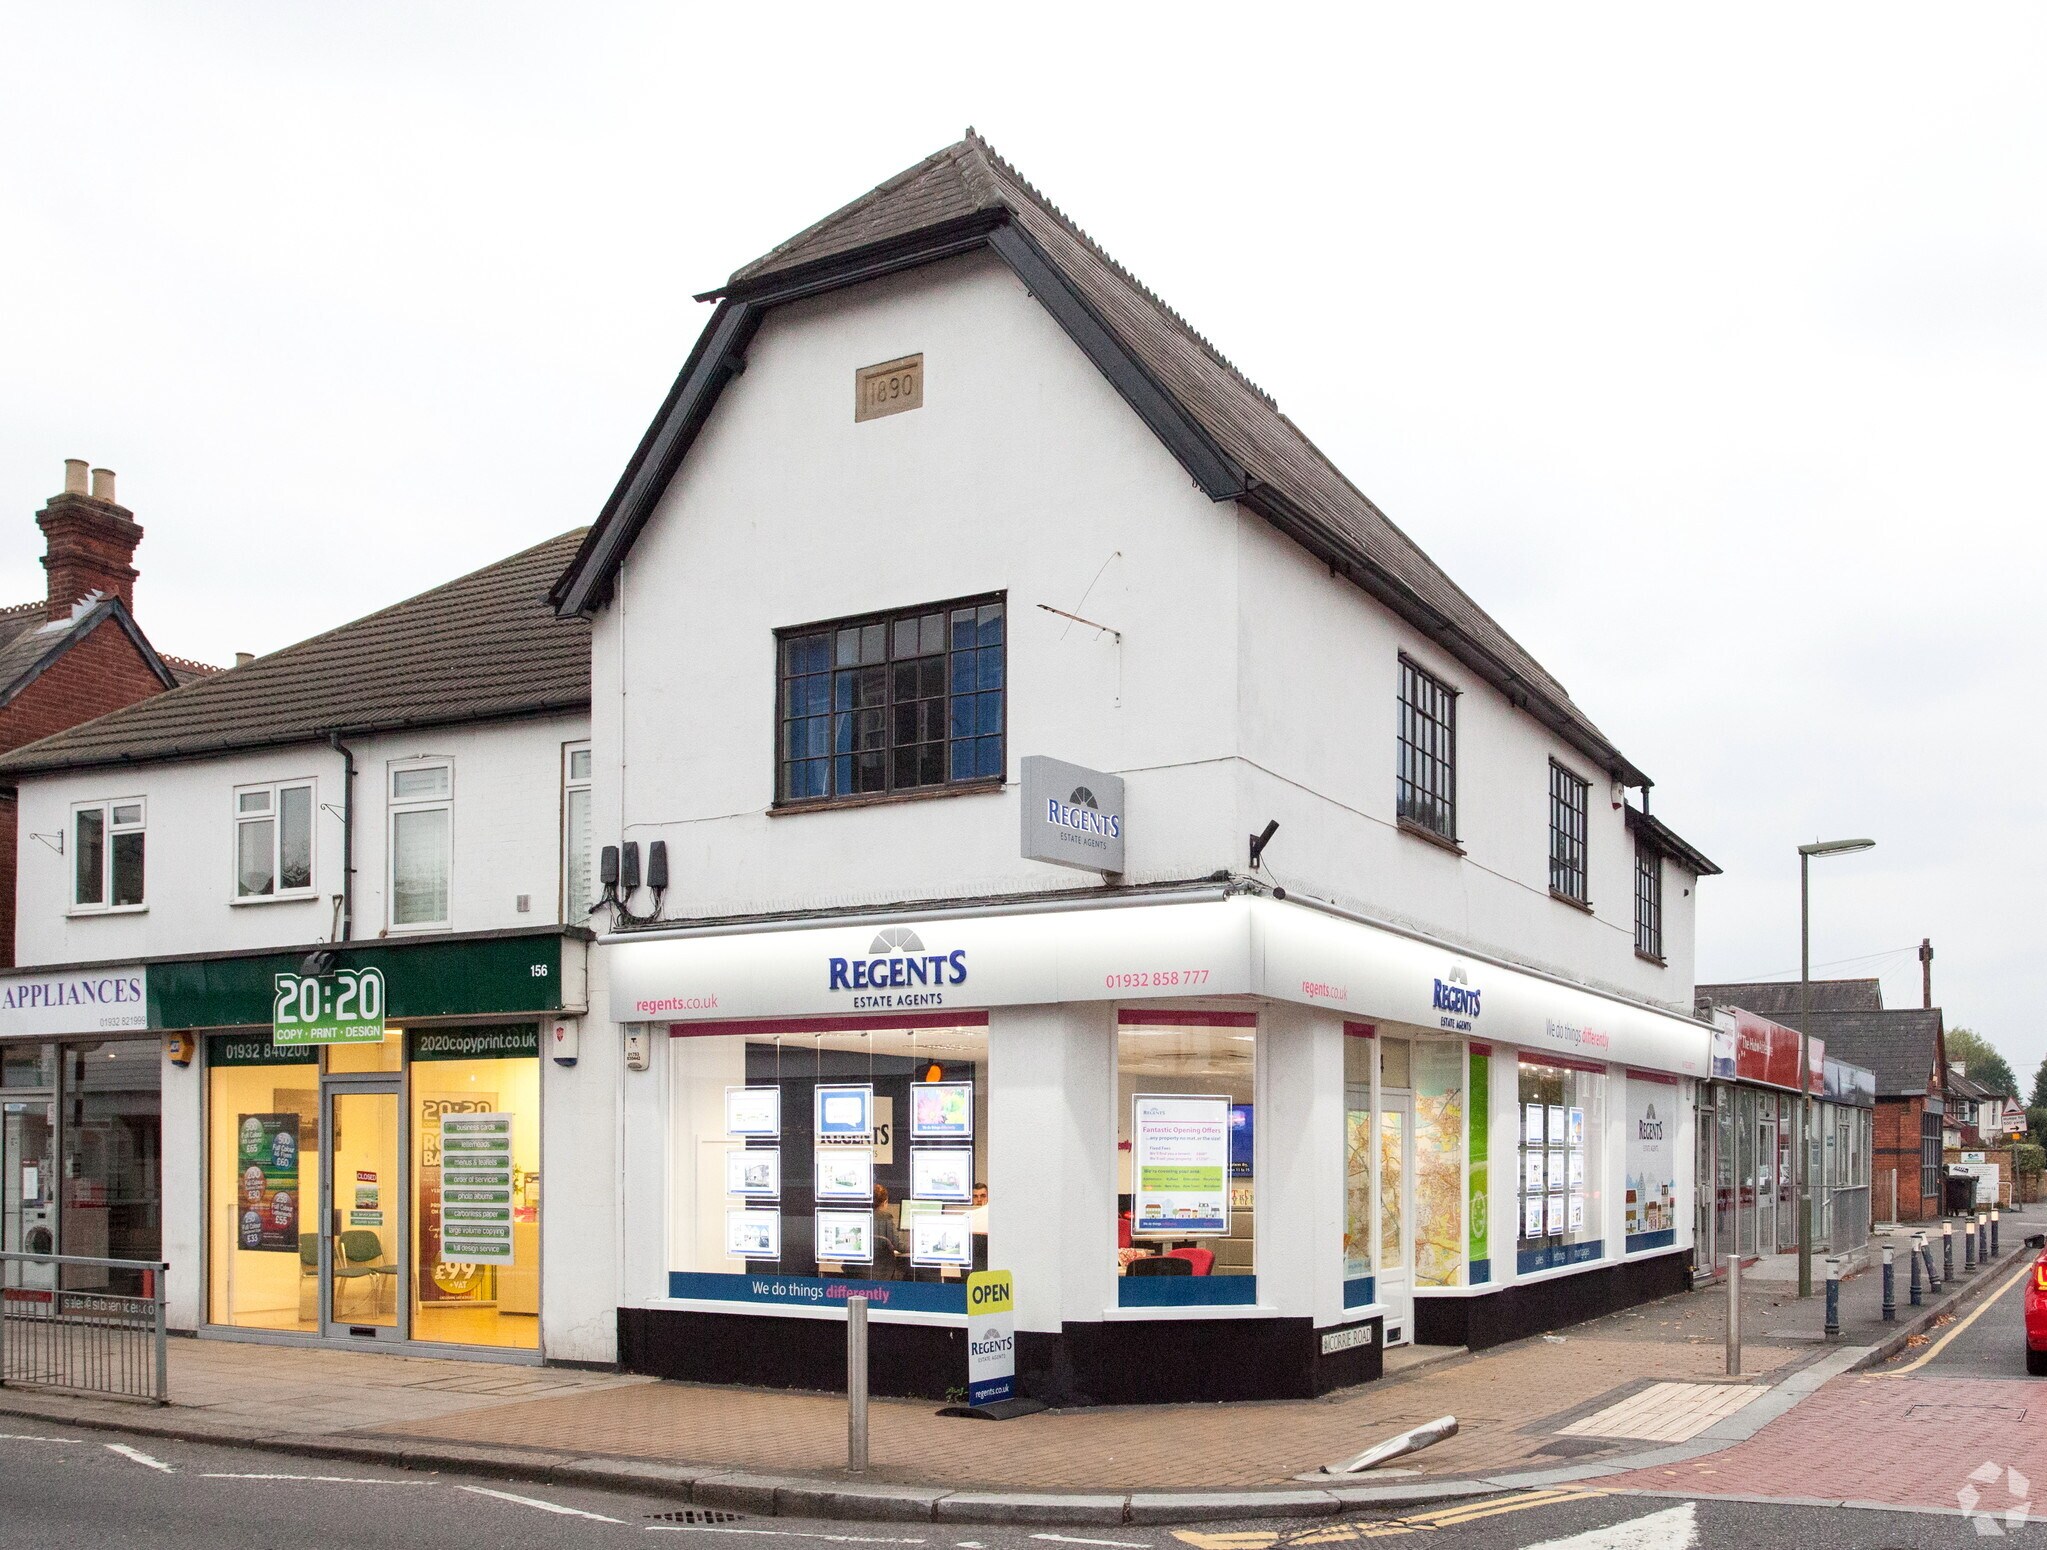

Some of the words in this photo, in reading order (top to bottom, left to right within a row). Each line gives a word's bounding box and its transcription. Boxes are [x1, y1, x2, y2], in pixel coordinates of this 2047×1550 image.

[872, 374, 913, 406] 1890
[1047, 798, 1120, 839] REGENTS
[1060, 831, 1082, 845] ESTATE
[1083, 838, 1107, 850] AGENTS
[530, 964, 548, 977] 156
[828, 950, 967, 990] REGENTS
[1105, 973, 1149, 989] 01932
[1152, 971, 1179, 987] 858
[1183, 969, 1210, 985] 777
[2, 977, 141, 1009] APPLIANCES
[277, 974, 380, 1023] 20:20
[853, 995, 893, 1008] ESTATE
[896, 993, 943, 1006] AGENTS
[1302, 980, 1348, 1001] regents.co.uk
[1432, 978, 1481, 1018] REGENTS
[636, 993, 718, 1015] regents.co.uk
[100, 1018, 119, 1027] 01932
[121, 1016, 146, 1026] 821999
[1440, 1016, 1455, 1029] ESTATE
[1456, 1020, 1472, 1031] AGENTS
[277, 1029, 302, 1040] COPY
[310, 1027, 338, 1039] PRINT
[345, 1025, 380, 1037] DESIGN
[420, 1032, 537, 1053] 2020copyprint.co.uk
[1546, 1017, 1555, 1037] We
[1556, 1020, 1563, 1039] do
[1564, 1022, 1581, 1047] things
[1582, 1026, 1609, 1052] differently
[226, 1044, 260, 1059] 01932
[263, 1044, 310, 1058] 840200
[1173, 1126, 1201, 1134] Opening
[1639, 1119, 1663, 1140] REGENTS
[448, 1228, 461, 1236] large
[483, 1228, 505, 1236] copying
[461, 1245, 479, 1253] design
[752, 1281, 769, 1294] We
[771, 1282, 787, 1295] do
[789, 1282, 823, 1300] things
[826, 1284, 890, 1303] differently
[972, 1283, 1009, 1304] OPEN
[971, 1336, 1013, 1355] REGENTS
[1353, 1327, 1371, 1344] ROAD
[975, 1383, 1010, 1400] regents.co.uk
